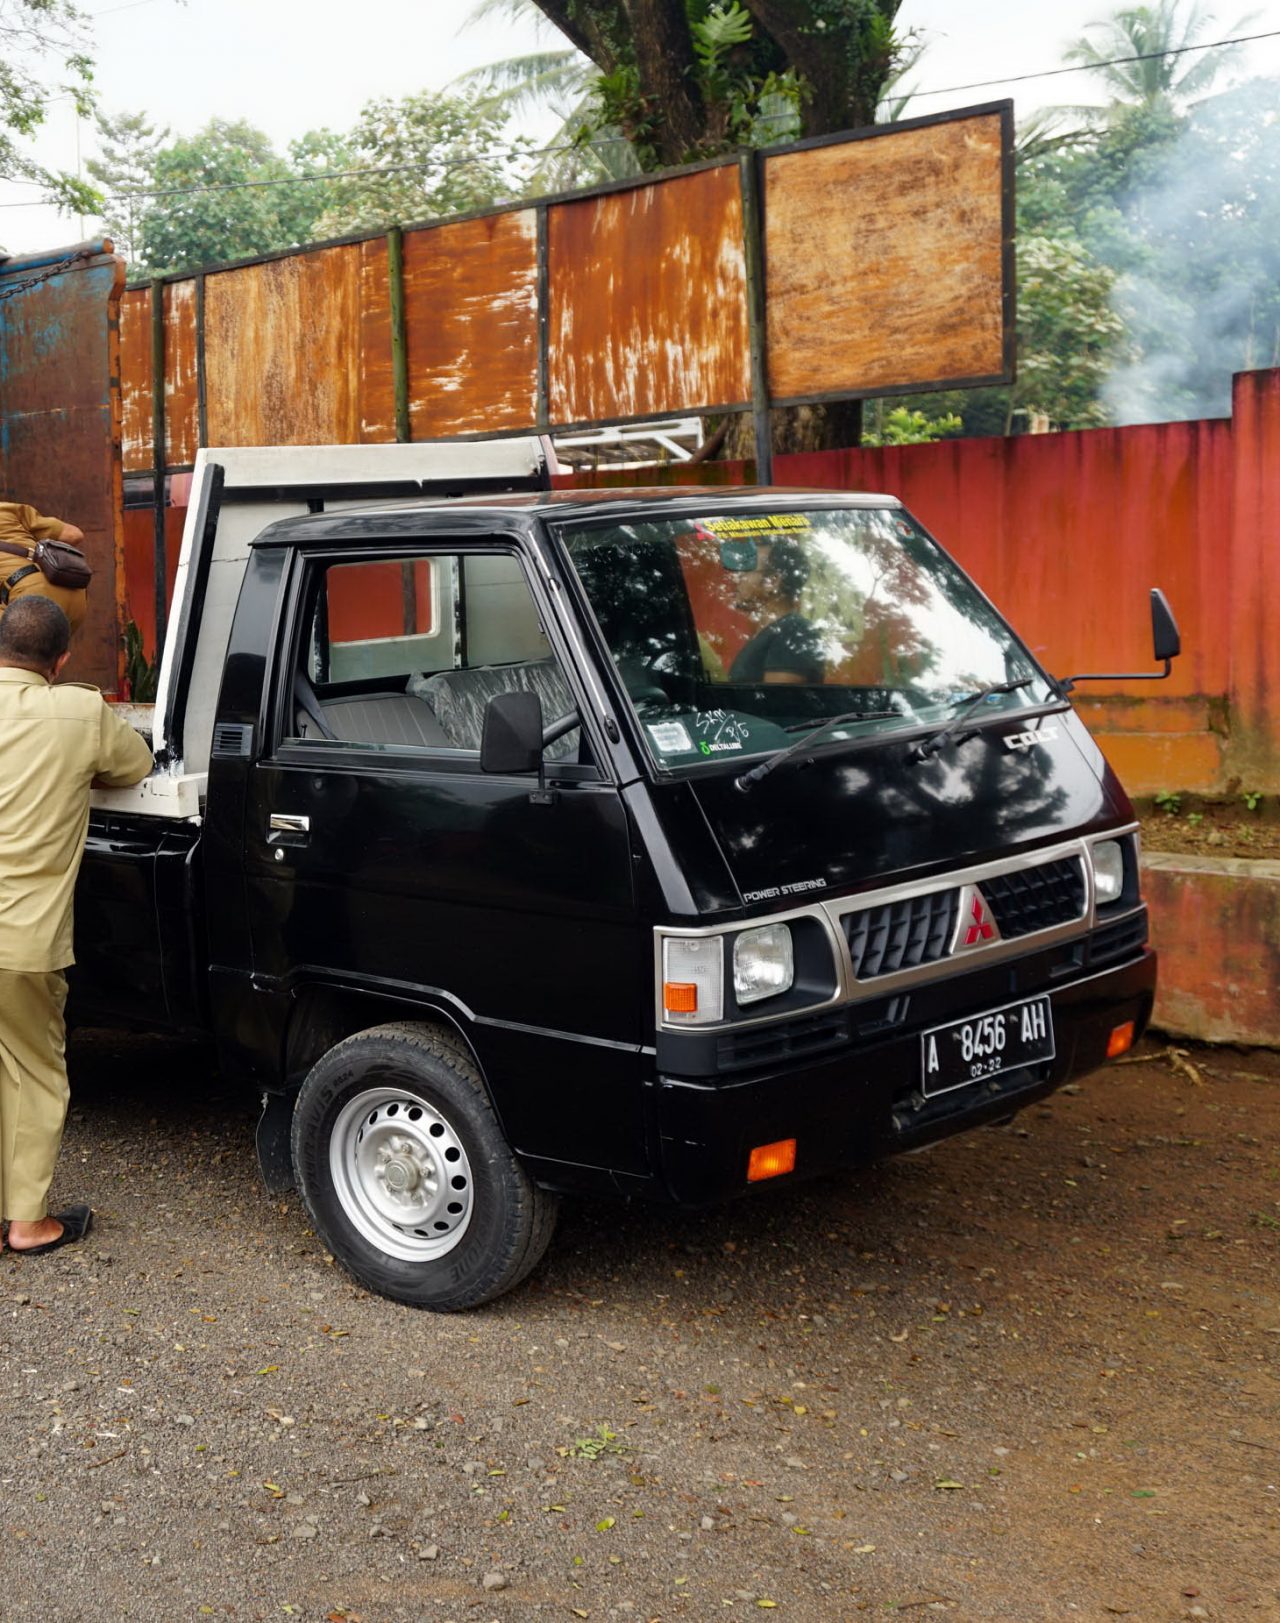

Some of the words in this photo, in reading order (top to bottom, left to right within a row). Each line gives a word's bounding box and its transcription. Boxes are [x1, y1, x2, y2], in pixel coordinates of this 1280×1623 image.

[1002, 727, 1059, 750] COLT
[743, 887, 781, 902] POWER
[780, 878, 827, 895] STEERING
[928, 1035, 939, 1073] A
[961, 1014, 1006, 1062] 8456
[1021, 1002, 1046, 1042] AH
